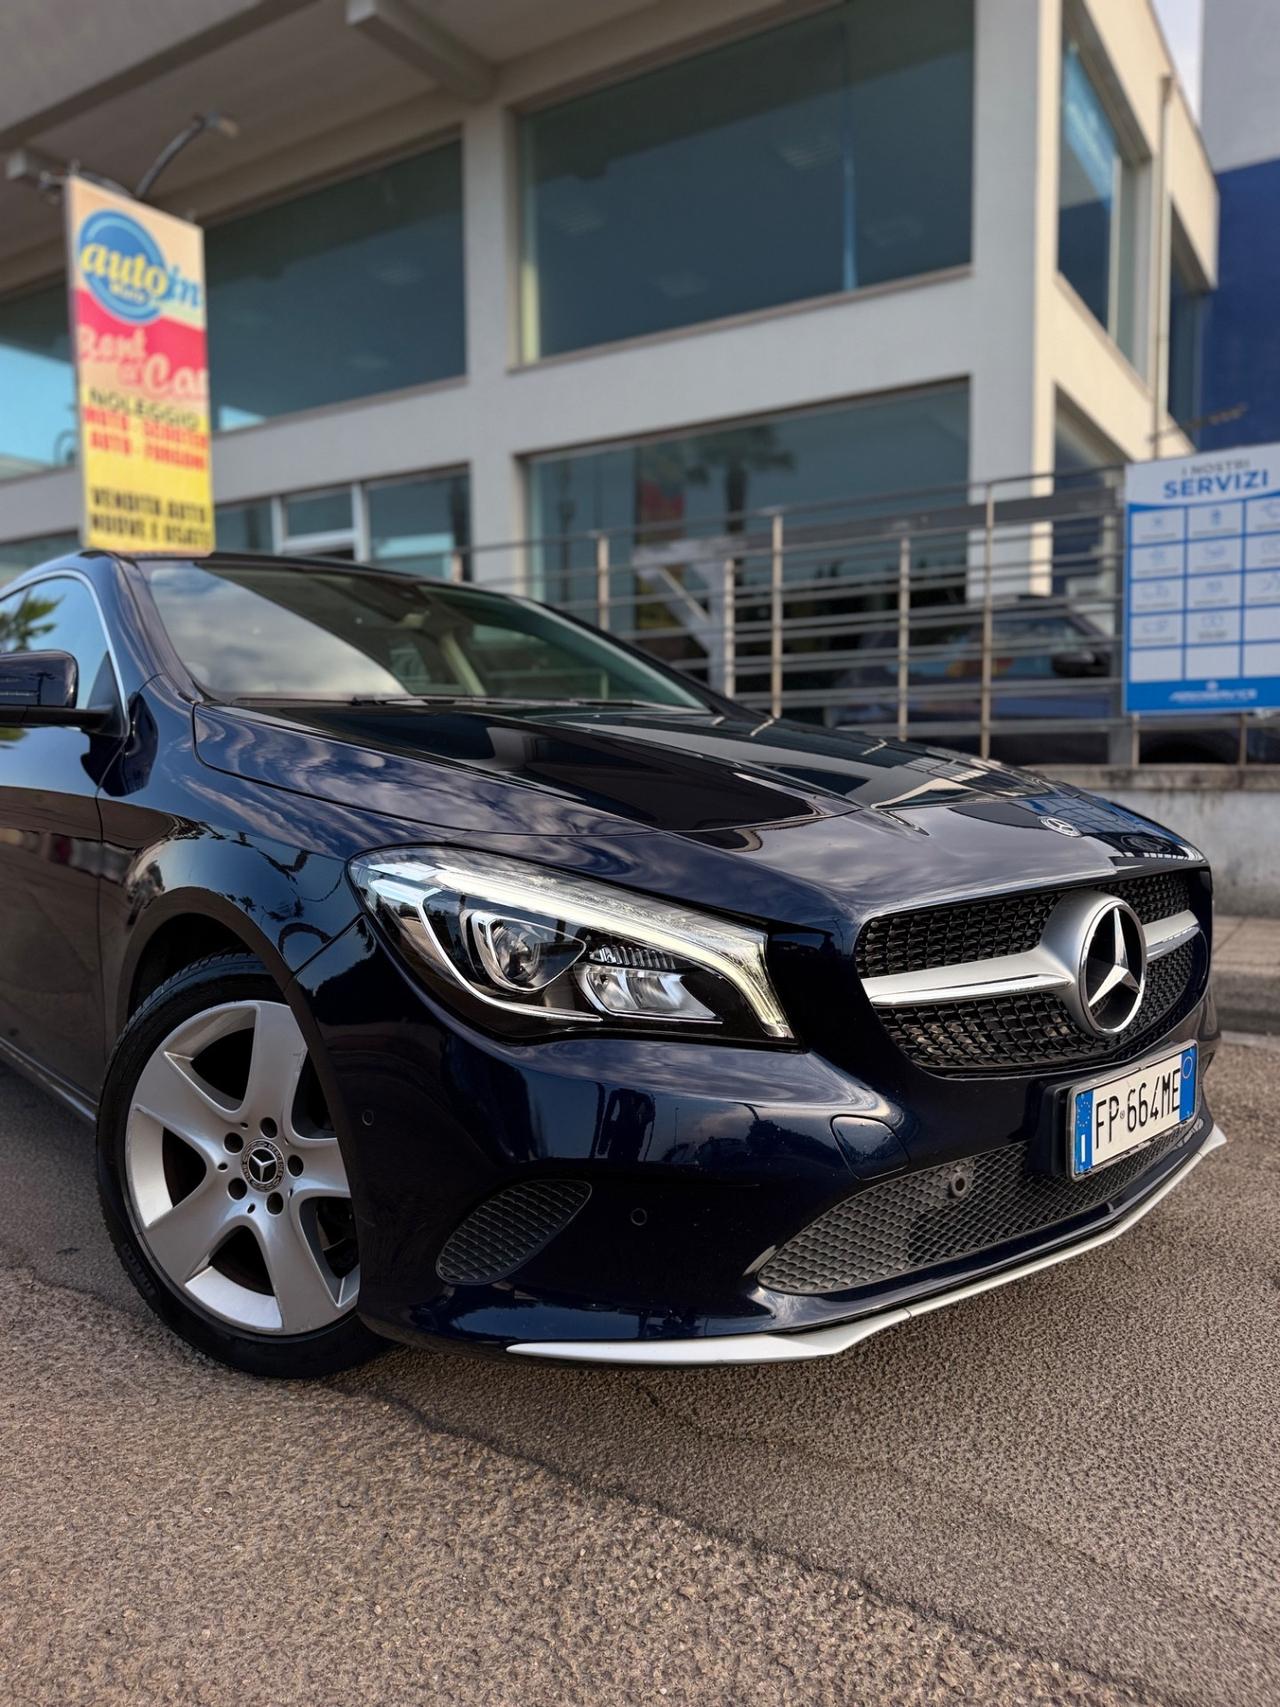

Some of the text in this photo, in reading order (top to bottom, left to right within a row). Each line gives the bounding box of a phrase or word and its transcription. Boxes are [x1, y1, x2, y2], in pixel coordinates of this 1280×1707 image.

[89, 387, 198, 430] NOLEGGIO
[1190, 459, 1251, 474] NOSTRI
[1163, 469, 1269, 499] SERVIZI
[91, 486, 207, 524] VENDITA AUTO
[91, 514, 144, 540] NUOVE
